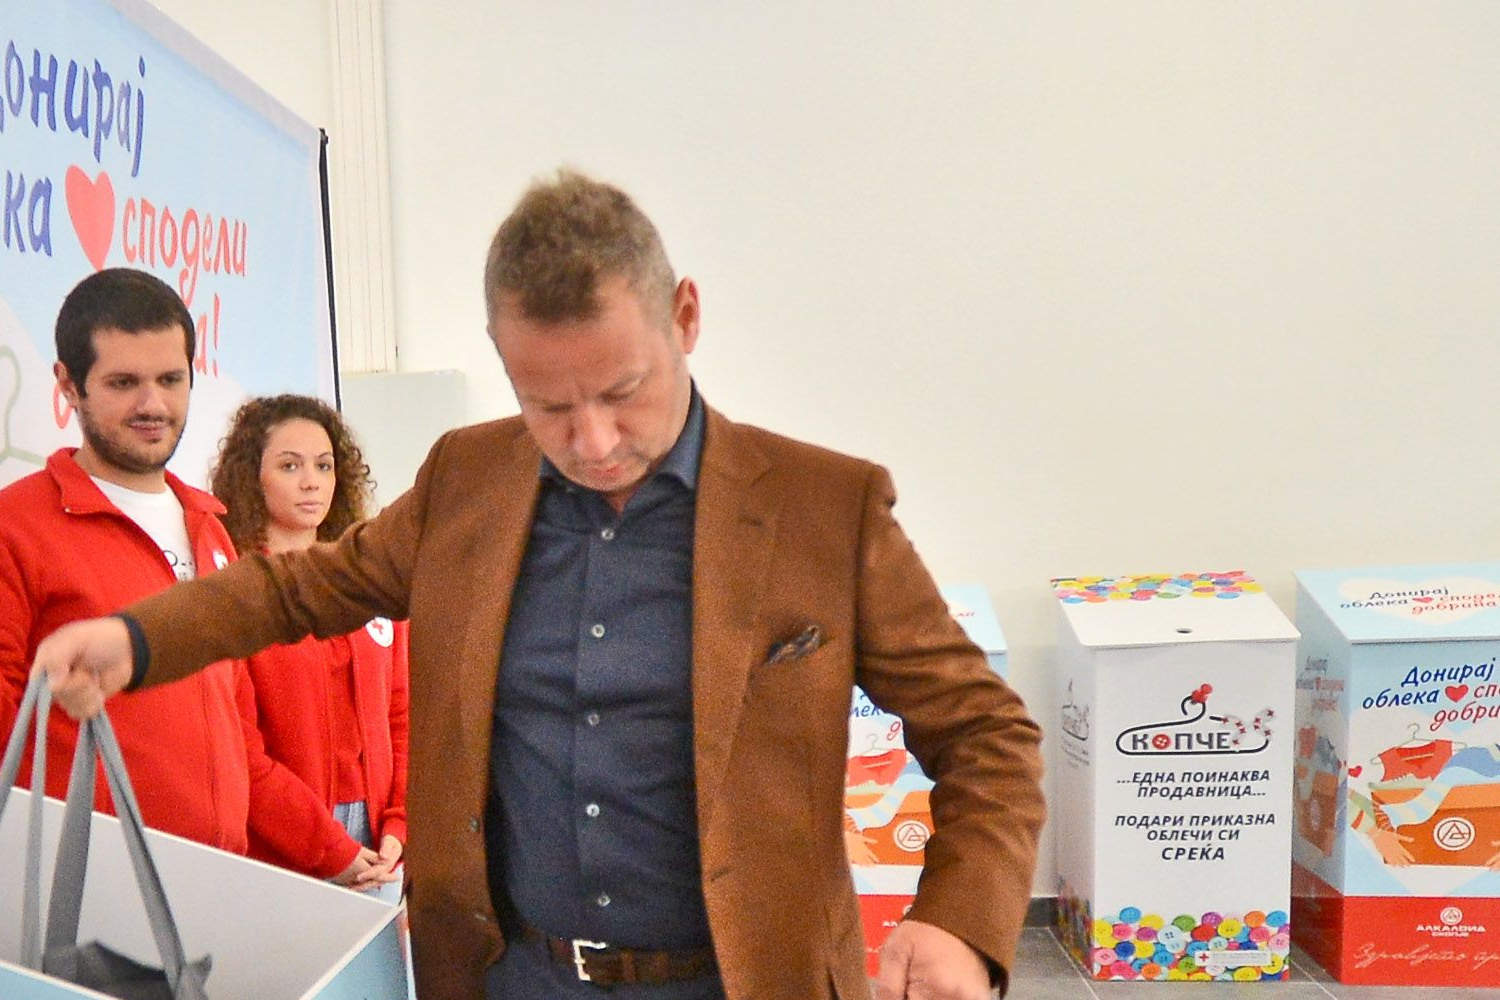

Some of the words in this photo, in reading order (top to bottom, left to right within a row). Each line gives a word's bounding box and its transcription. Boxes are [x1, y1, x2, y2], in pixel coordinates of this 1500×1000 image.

[123, 197, 247, 305] сподели
[1340, 598, 1408, 609] облека
[1440, 592, 1500, 604] споде
[1370, 587, 1449, 600] Донирај
[1401, 657, 1496, 688] Донирај
[1362, 688, 1440, 709] облека
[1132, 732, 1230, 750] КОПЧЕ
[1117, 772, 1176, 786] ...ЕДНА
[1181, 770, 1270, 783] ПОИНАКВА
[1137, 786, 1266, 800] ПРОДАВНИЦА...
[1115, 815, 1184, 829] ПОДАРИ
[1189, 814, 1275, 827] ПРИКАЗНА
[1147, 830, 1213, 841] ОБЛЕЧИ
[1218, 829, 1240, 841] СИ
[1161, 843, 1225, 860] СРЕЌА
